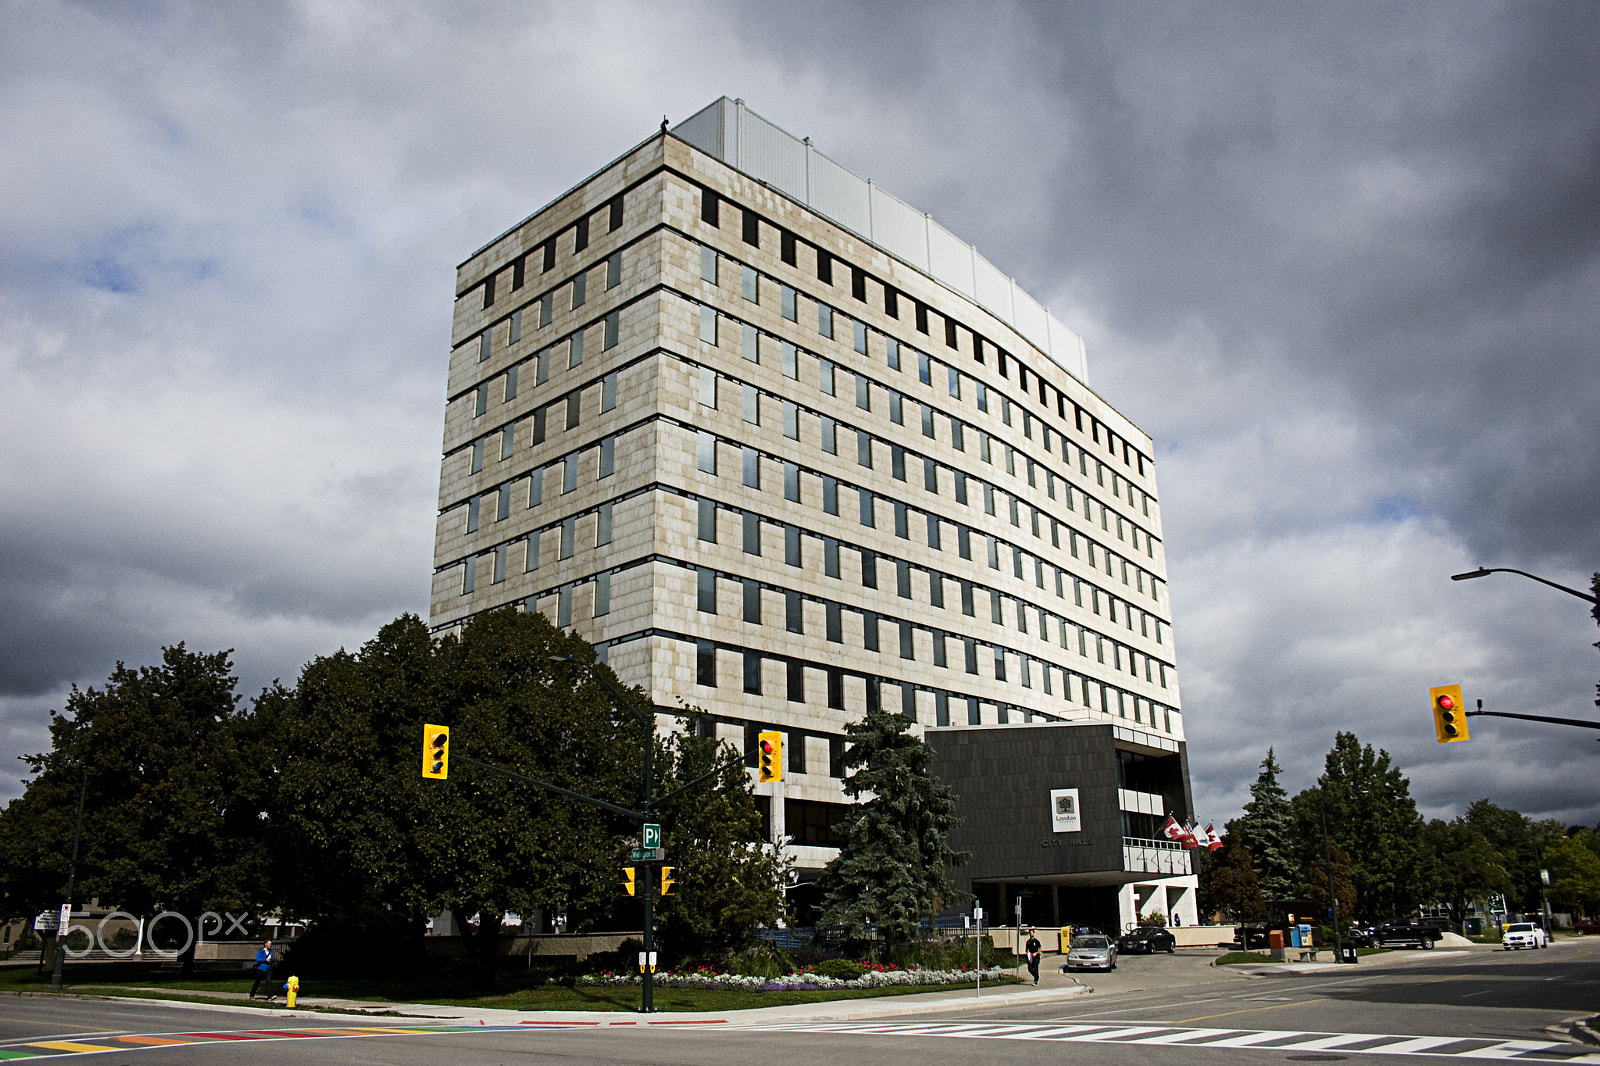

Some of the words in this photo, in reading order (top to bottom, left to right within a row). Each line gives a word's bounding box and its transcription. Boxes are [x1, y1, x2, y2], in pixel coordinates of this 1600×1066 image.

[646, 828, 654, 844] P
[1041, 838, 1063, 848] CITY
[1068, 838, 1093, 847] HALL
